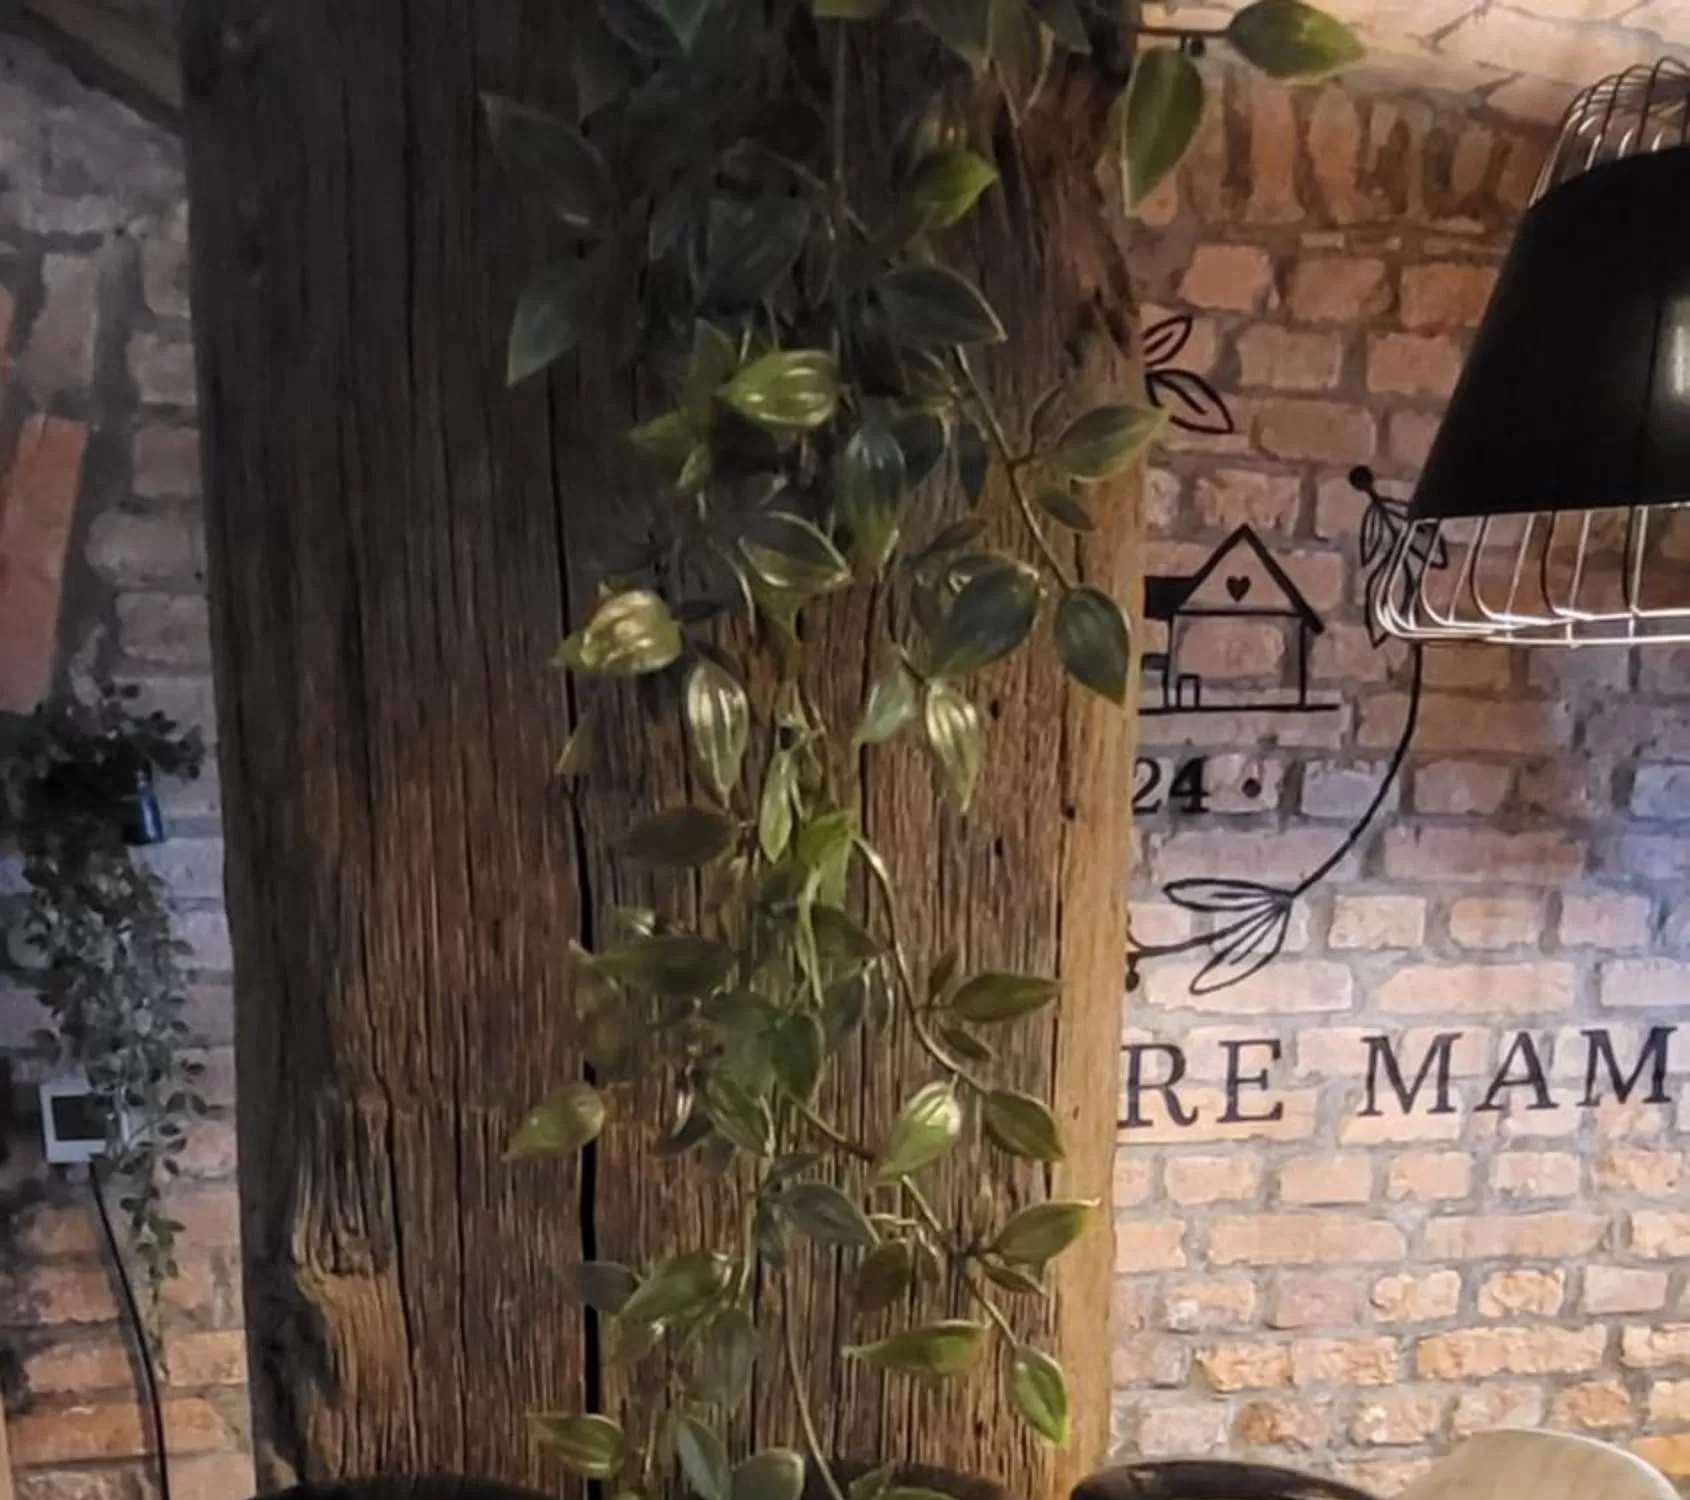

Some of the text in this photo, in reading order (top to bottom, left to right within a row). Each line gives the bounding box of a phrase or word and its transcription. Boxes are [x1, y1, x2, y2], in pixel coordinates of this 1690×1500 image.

[1131, 756, 1210, 816] 24
[1116, 1026, 1678, 1129] RE MAM
